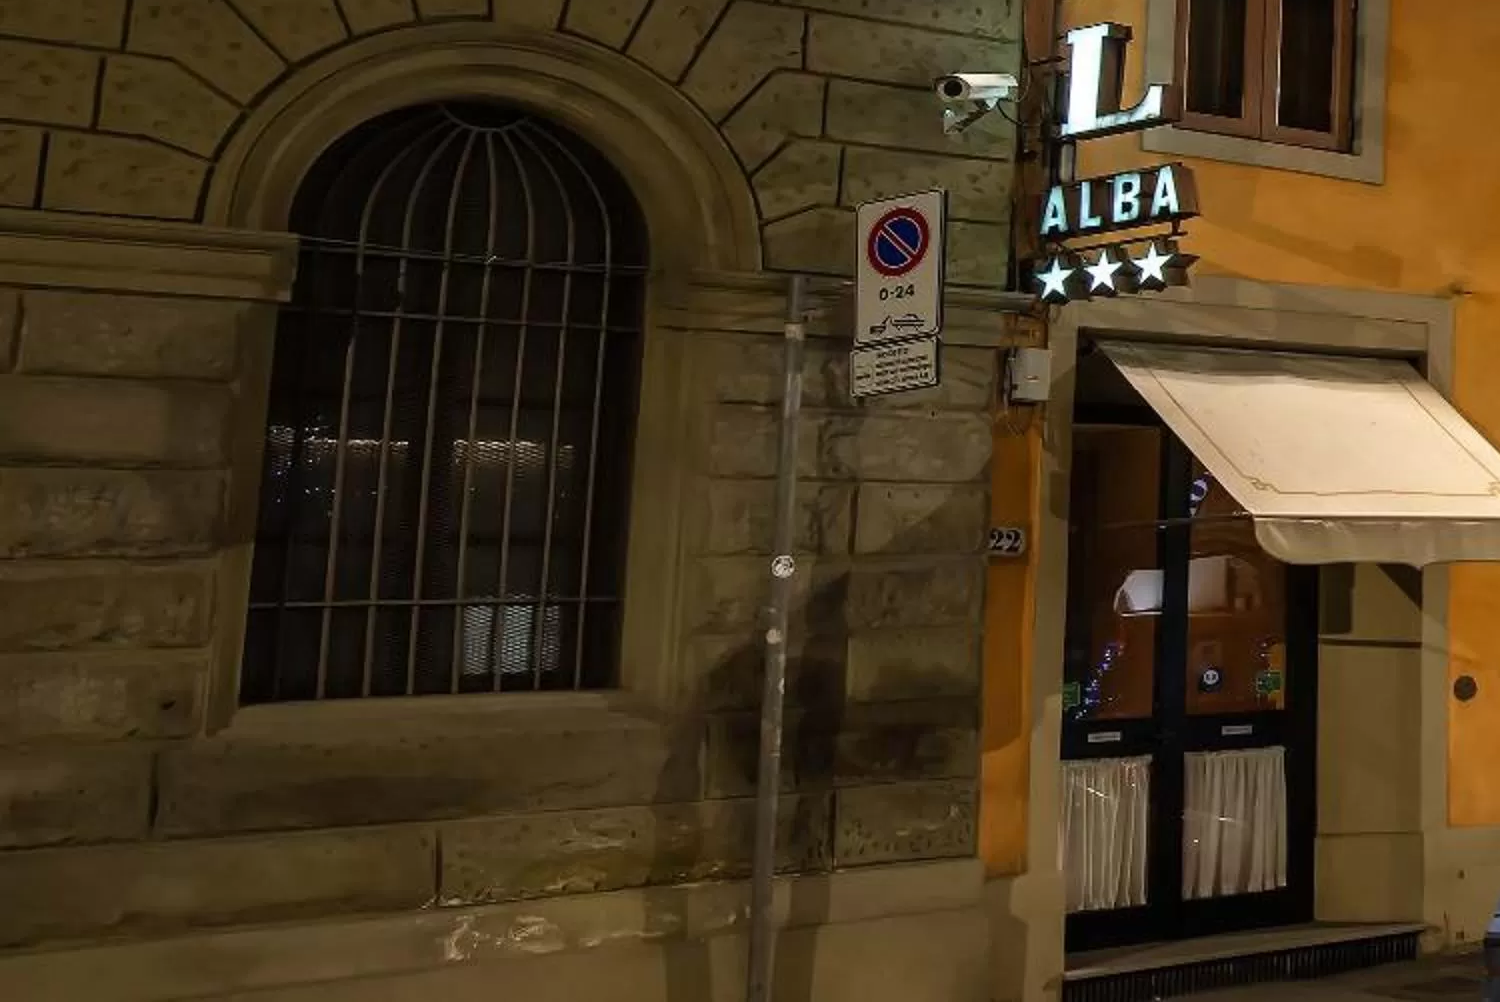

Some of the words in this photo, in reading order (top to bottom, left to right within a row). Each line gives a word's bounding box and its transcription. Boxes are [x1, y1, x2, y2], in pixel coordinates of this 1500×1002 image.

[1040, 165, 1180, 235] ALBA
[880, 284, 914, 301] 0-24
[987, 529, 1021, 553] 22
